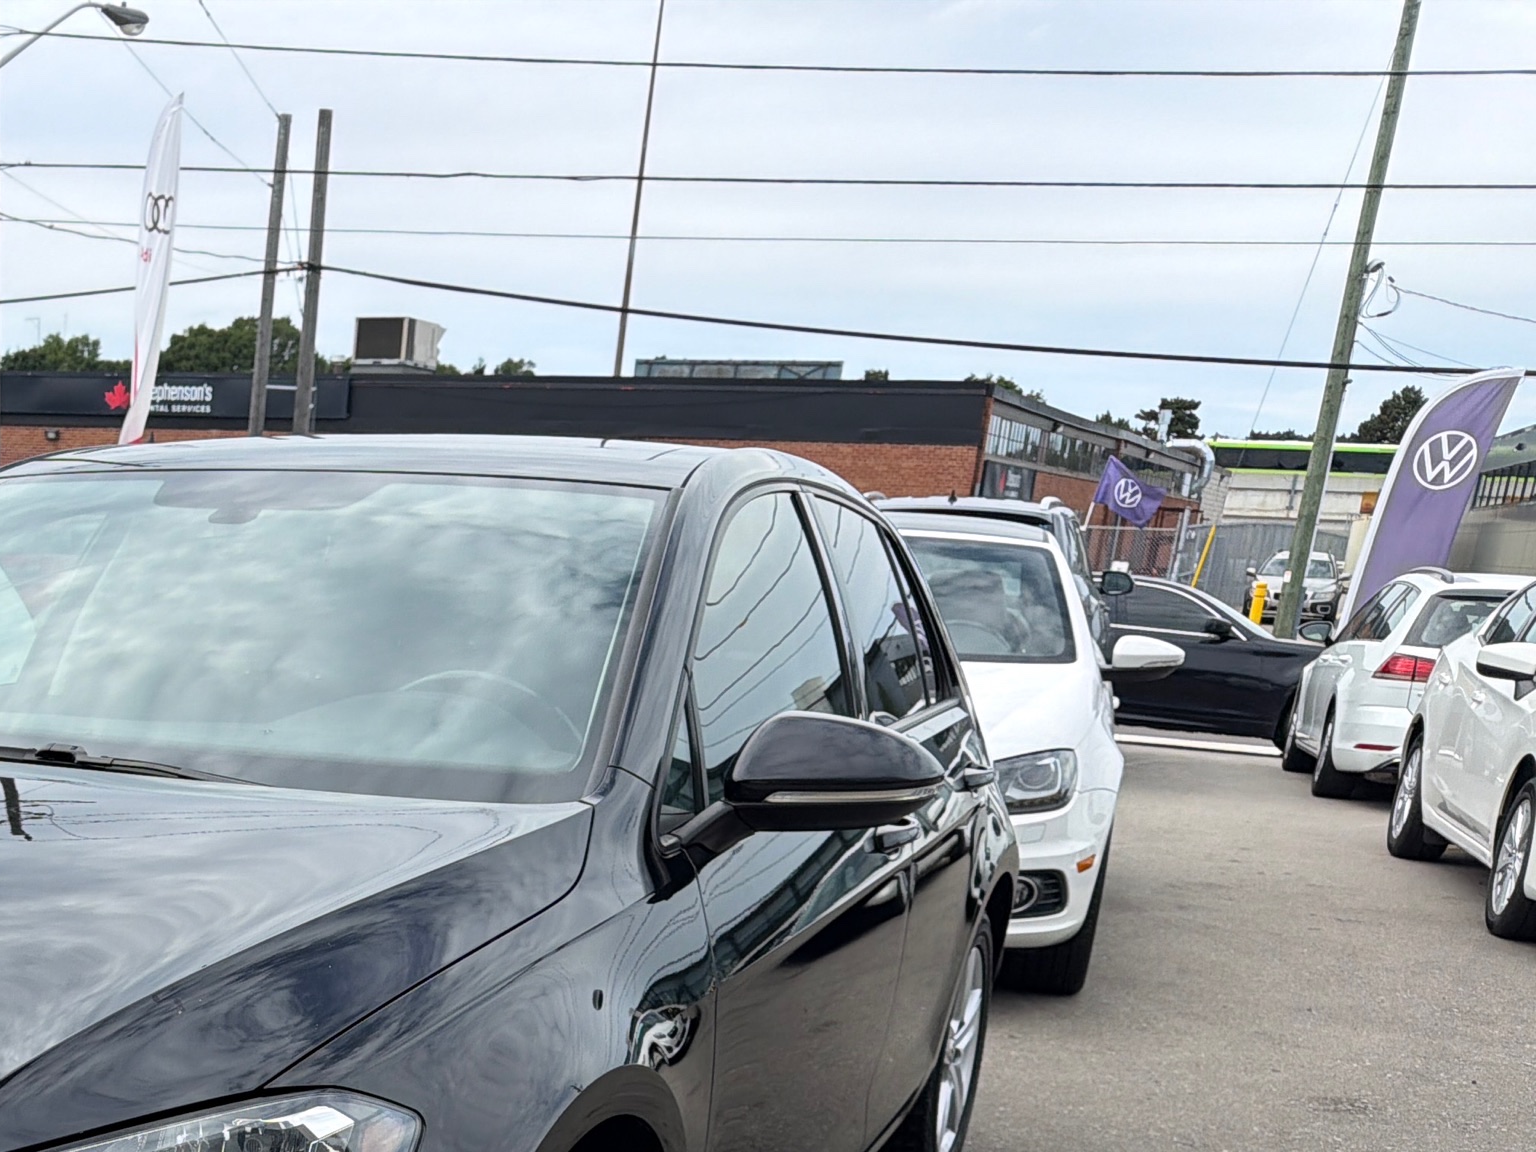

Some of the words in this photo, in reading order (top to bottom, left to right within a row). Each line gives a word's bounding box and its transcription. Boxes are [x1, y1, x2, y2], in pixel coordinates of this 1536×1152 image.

[151, 382, 213, 402] ephenson's
[150, 403, 169, 413] NTAL
[171, 404, 212, 413] SERVICES
[1413, 430, 1478, 490] VW
